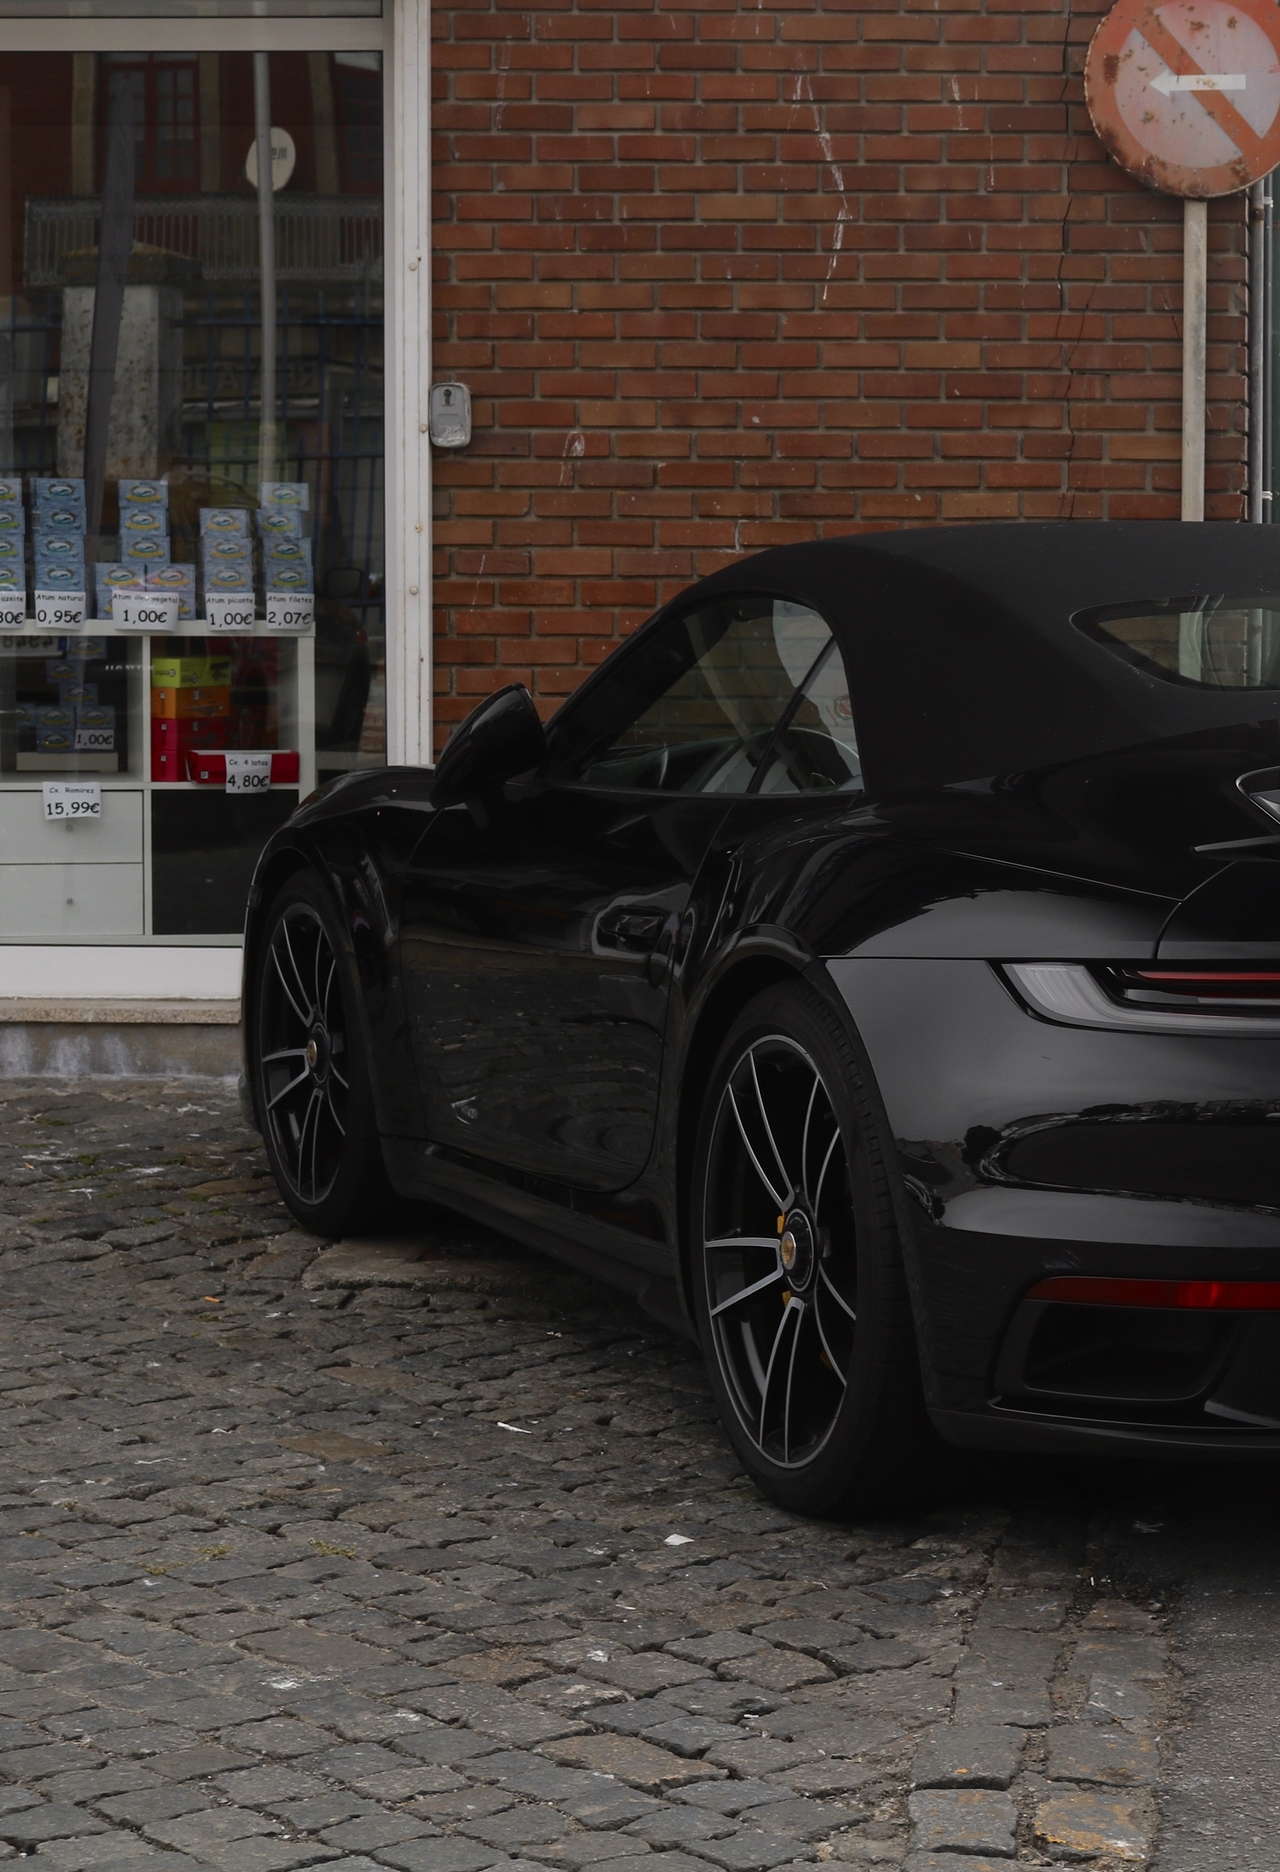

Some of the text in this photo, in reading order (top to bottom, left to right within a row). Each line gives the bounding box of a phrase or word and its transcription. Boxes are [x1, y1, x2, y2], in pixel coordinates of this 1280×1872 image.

[152, 596, 178, 604] vegetal
[228, 597, 253, 605] picante
[37, 609, 82, 624] 0,95€
[123, 609, 167, 624] 1,00€
[209, 612, 252, 627] 1,00€
[268, 611, 311, 626] 2,07€
[76, 734, 113, 746] 1,00€
[227, 775, 269, 789] 4,80€
[46, 801, 100, 816] 15,99€
